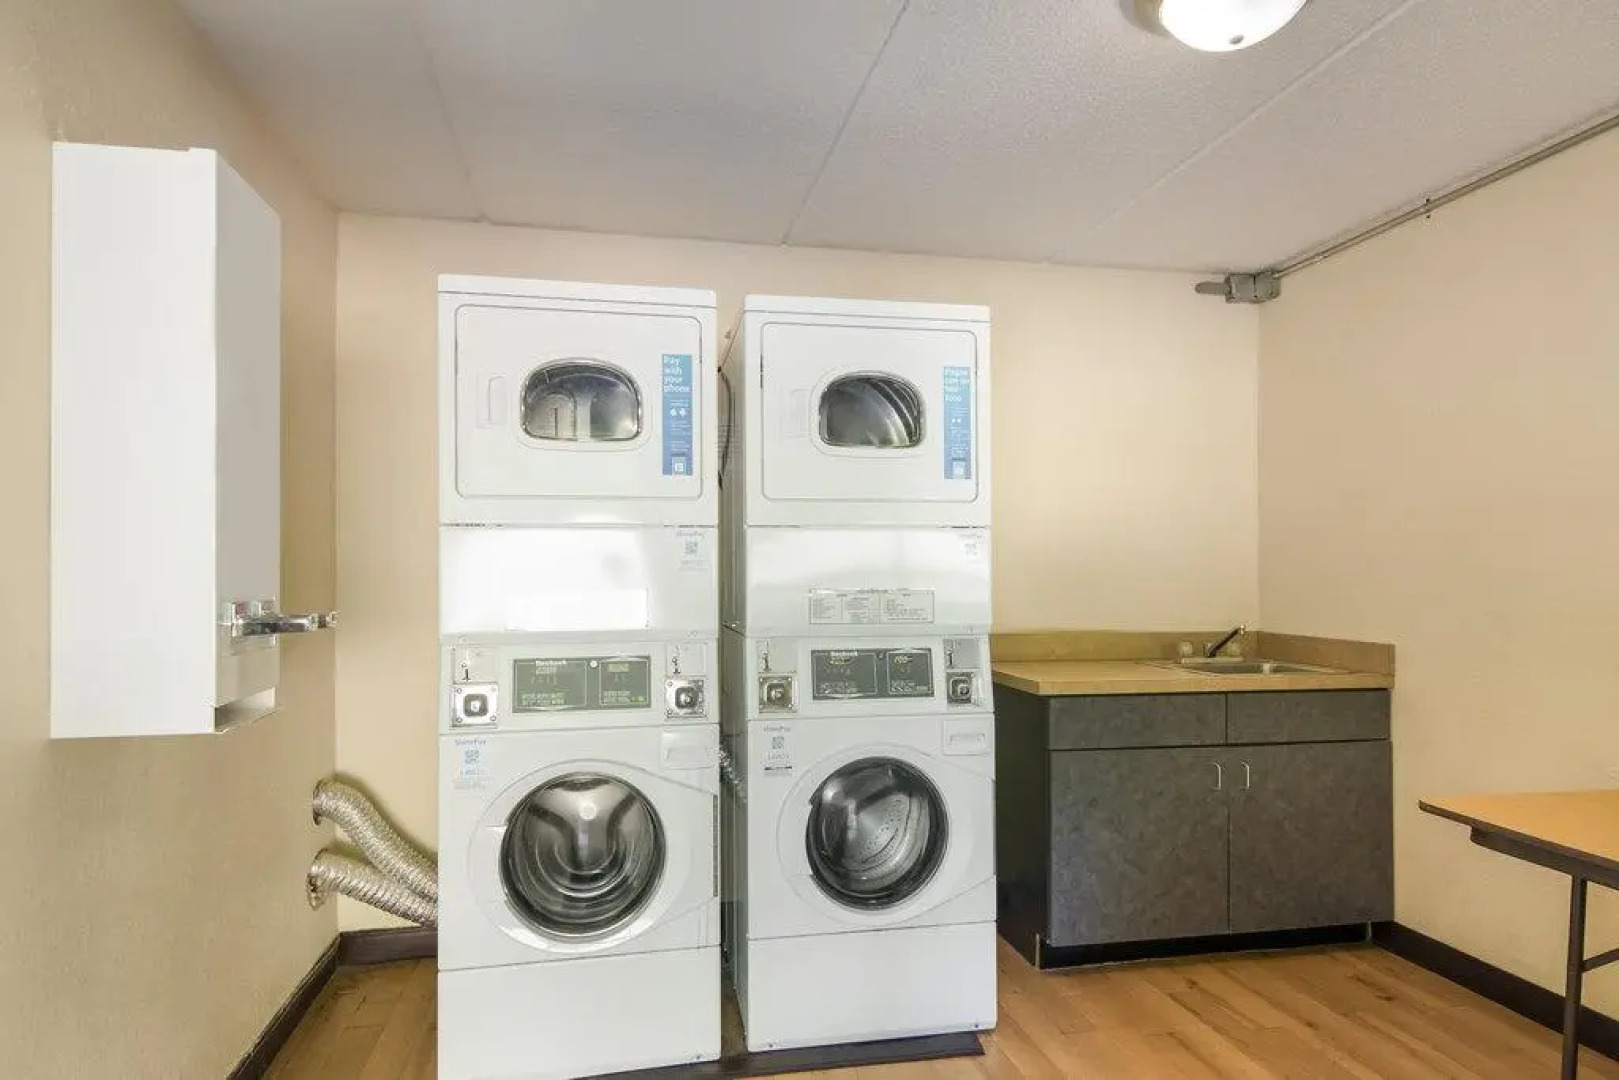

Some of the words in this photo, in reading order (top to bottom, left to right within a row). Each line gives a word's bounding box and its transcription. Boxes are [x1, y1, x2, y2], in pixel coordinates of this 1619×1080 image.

[663, 355, 681, 366] Pay
[663, 366, 682, 375] with
[663, 377, 682, 386] your
[663, 384, 690, 393] phone
